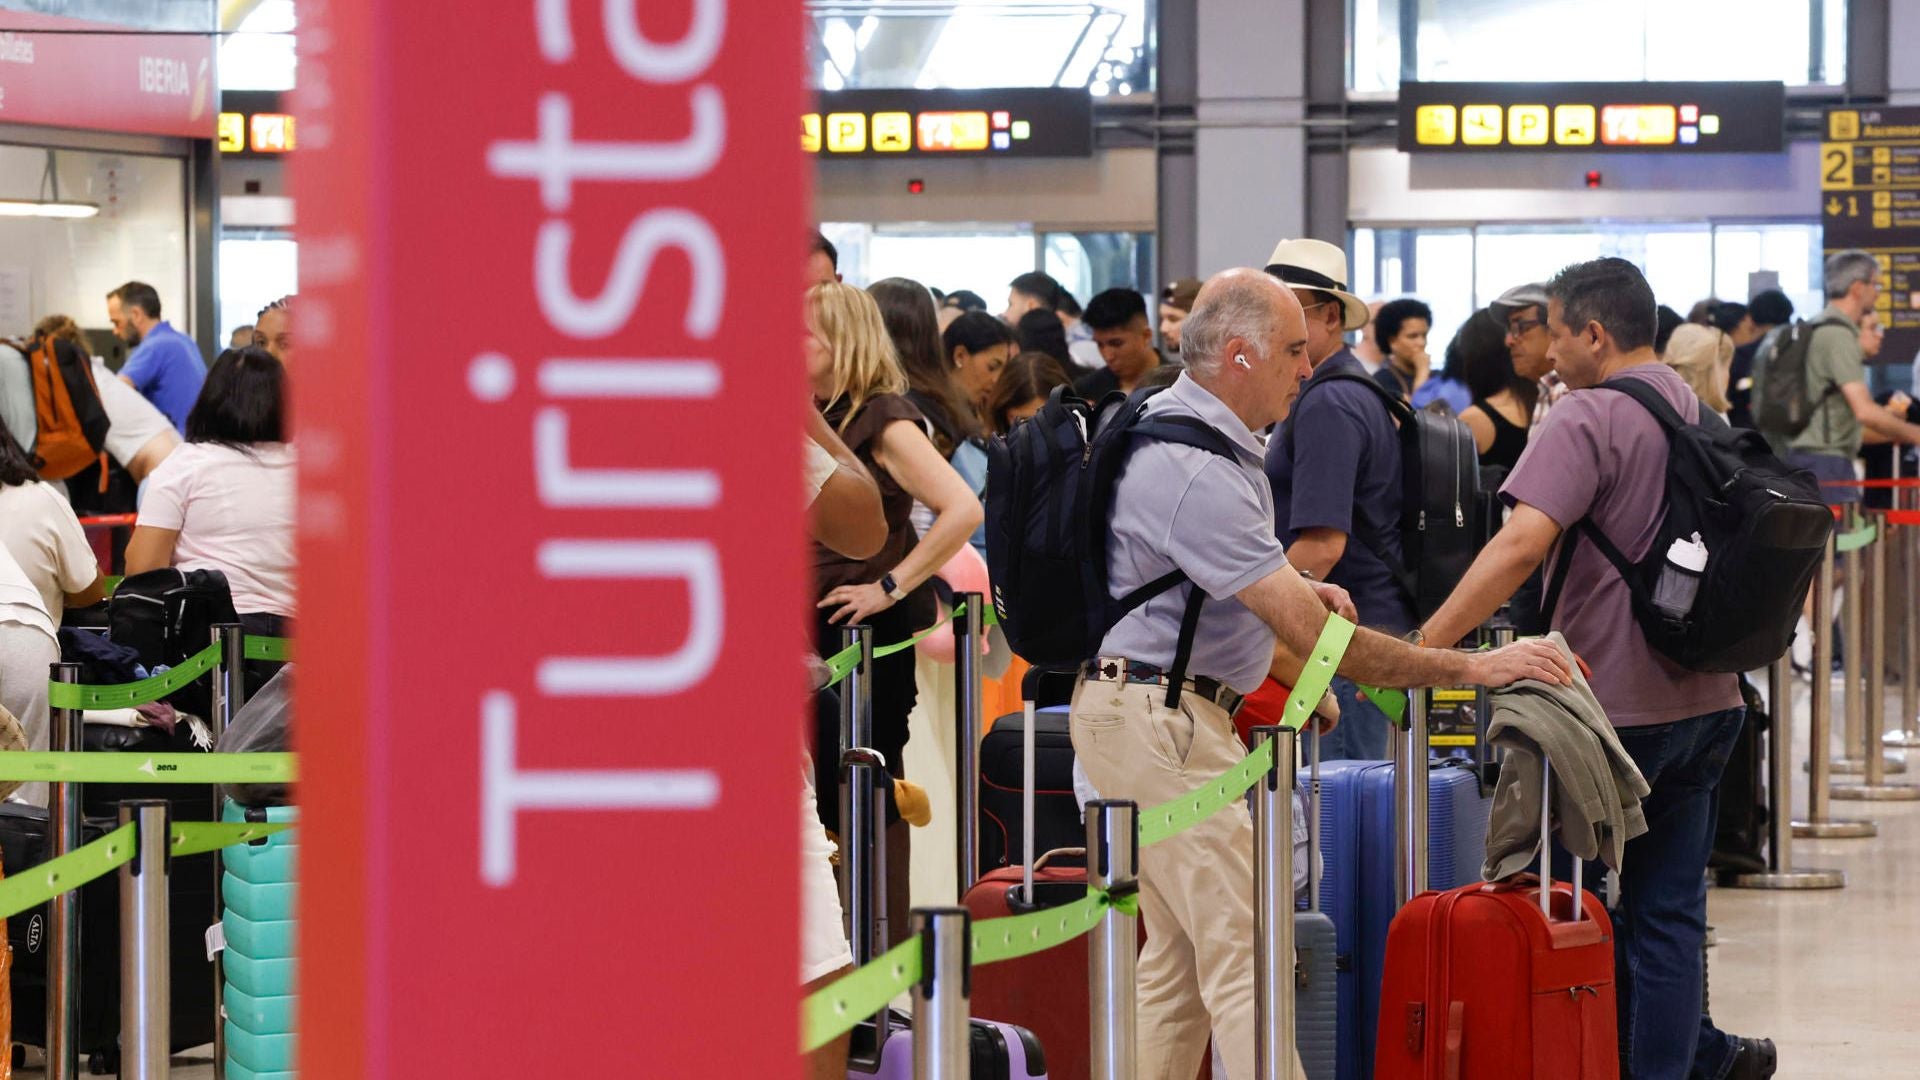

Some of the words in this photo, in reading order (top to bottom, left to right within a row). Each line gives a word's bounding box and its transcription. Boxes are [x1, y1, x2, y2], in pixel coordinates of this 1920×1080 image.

[139, 56, 189, 95] IBERIA
[1826, 150, 1847, 182] 2
[1847, 197, 1858, 217] 1
[466, 0, 727, 888] Turista
[156, 763, 178, 772] aena
[30, 920, 40, 946] ALTA
